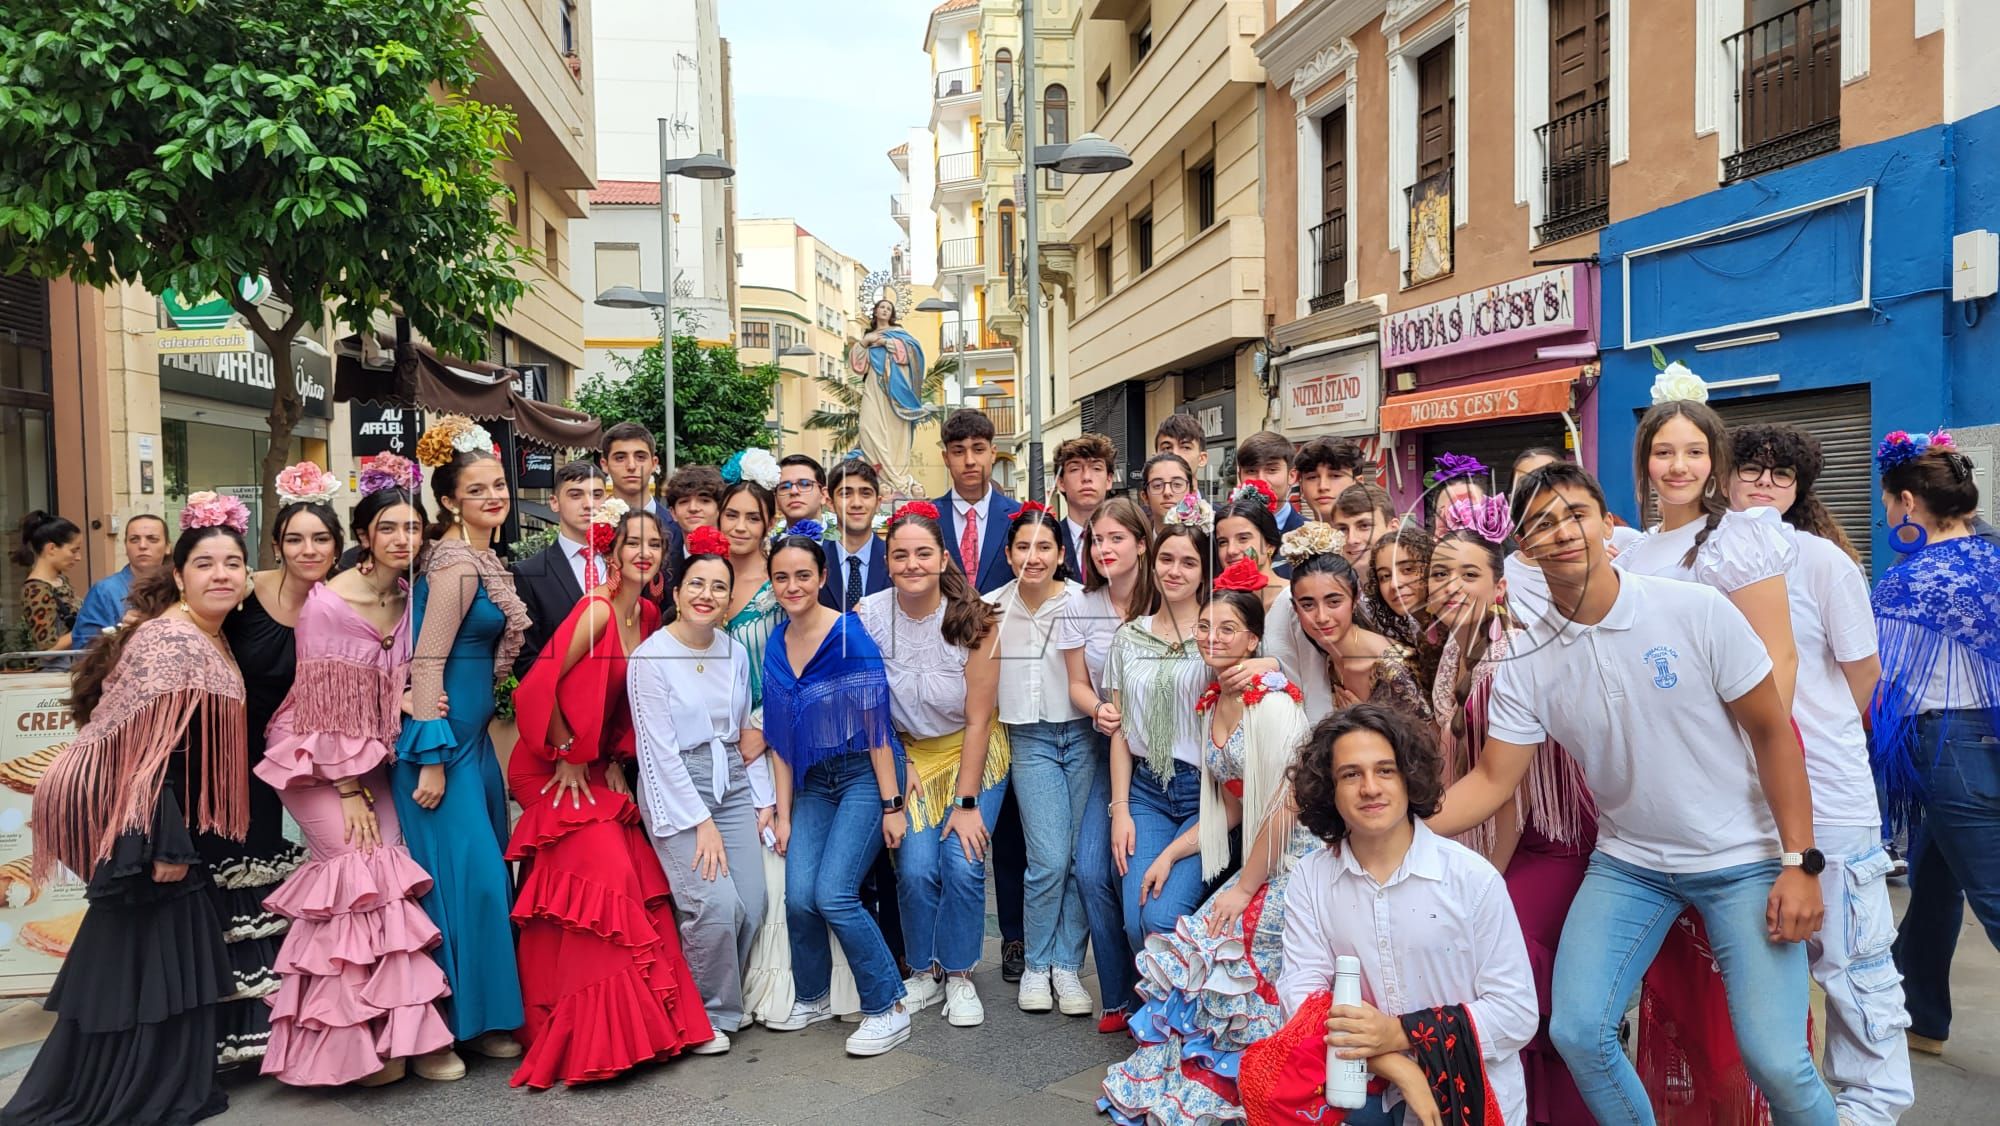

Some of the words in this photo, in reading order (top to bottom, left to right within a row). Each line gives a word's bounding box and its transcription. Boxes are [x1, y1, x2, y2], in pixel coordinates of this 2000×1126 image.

[1390, 298, 1463, 356] MODAS
[1474, 279, 1560, 336] CESY'S
[1325, 376, 1361, 402] STAND
[1410, 399, 1459, 424] MODAS
[1464, 389, 1519, 419] CESY'S
[36, 698, 65, 709] delic
[17, 711, 75, 732] CREP
